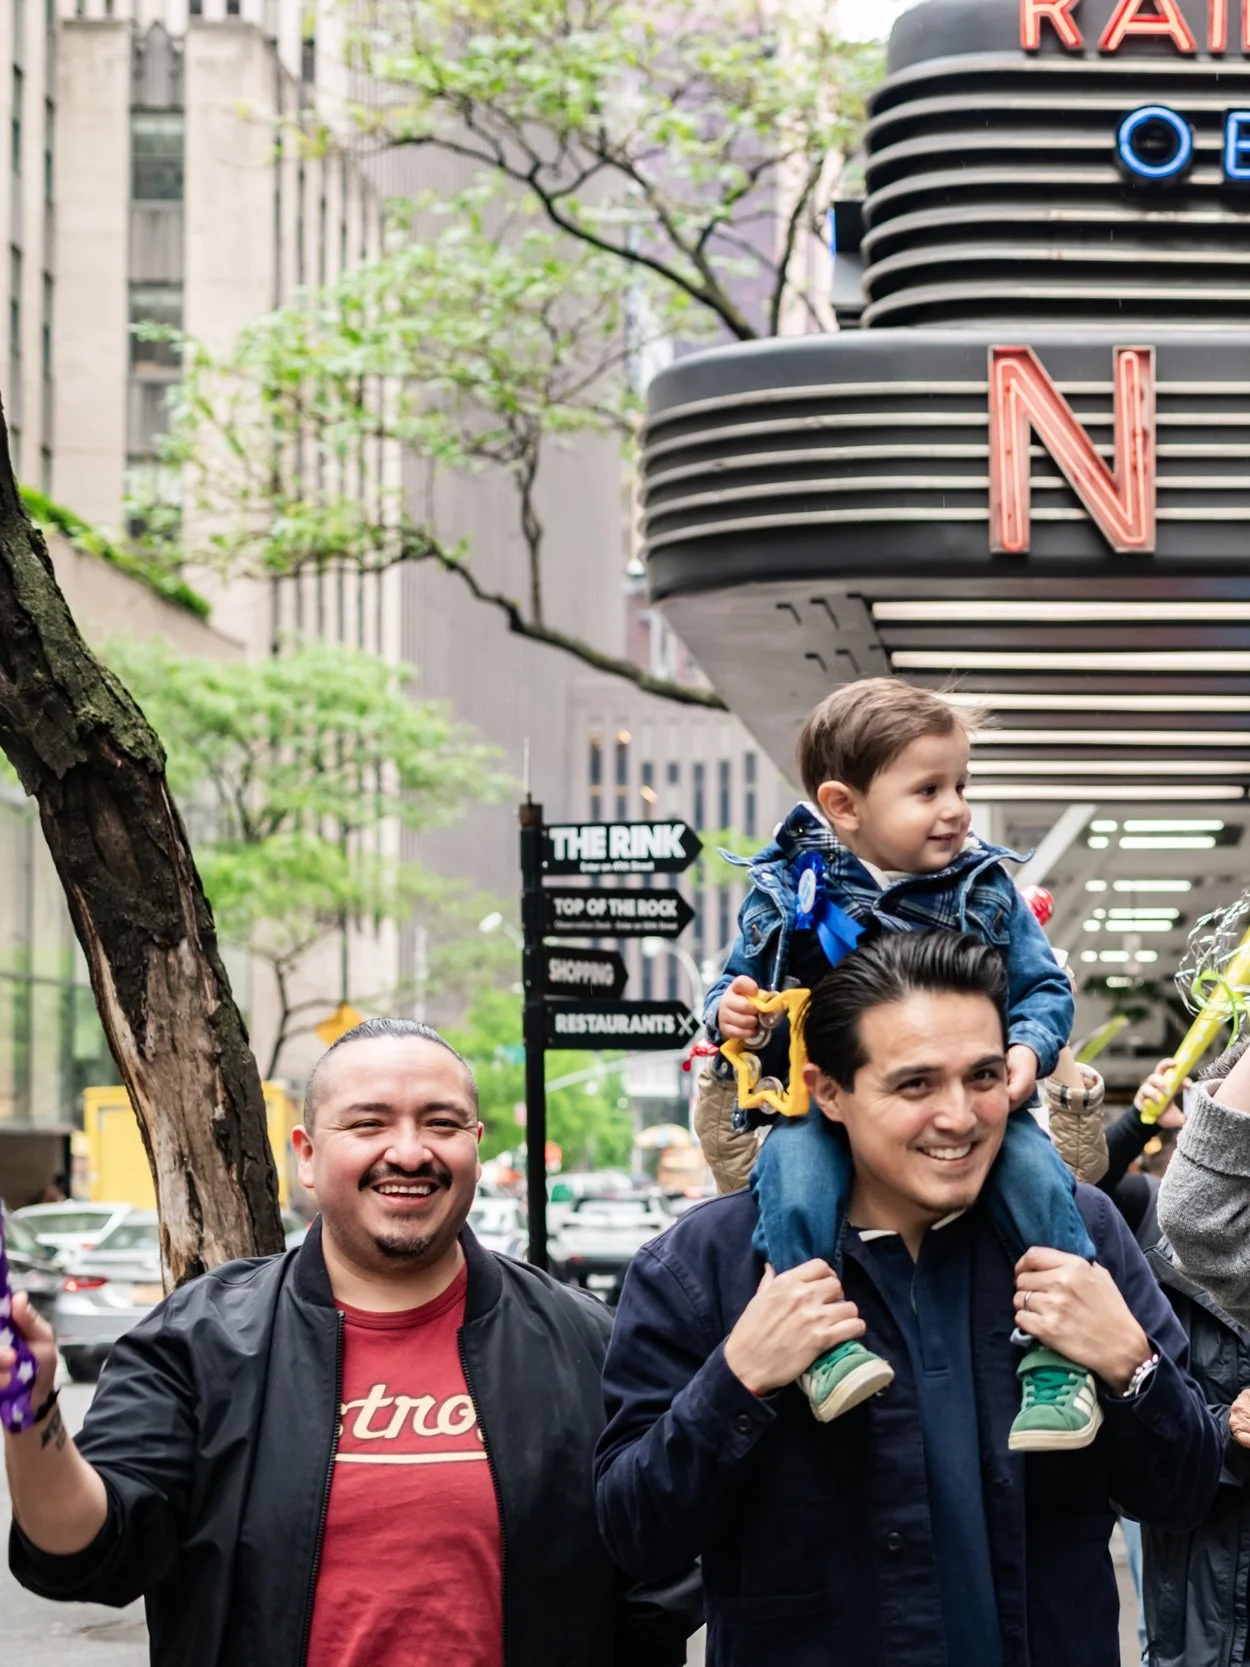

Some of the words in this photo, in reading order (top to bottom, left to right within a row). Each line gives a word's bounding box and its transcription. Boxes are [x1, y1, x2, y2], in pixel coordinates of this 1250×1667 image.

[549, 826, 607, 860] THE
[609, 824, 686, 859] RINK
[553, 897, 585, 916] TOP
[586, 897, 607, 916] OF
[607, 898, 636, 917] THE
[637, 899, 678, 917] ROCK
[548, 957, 615, 987] SHOPPING
[555, 1012, 676, 1035] RESTAURANTS
